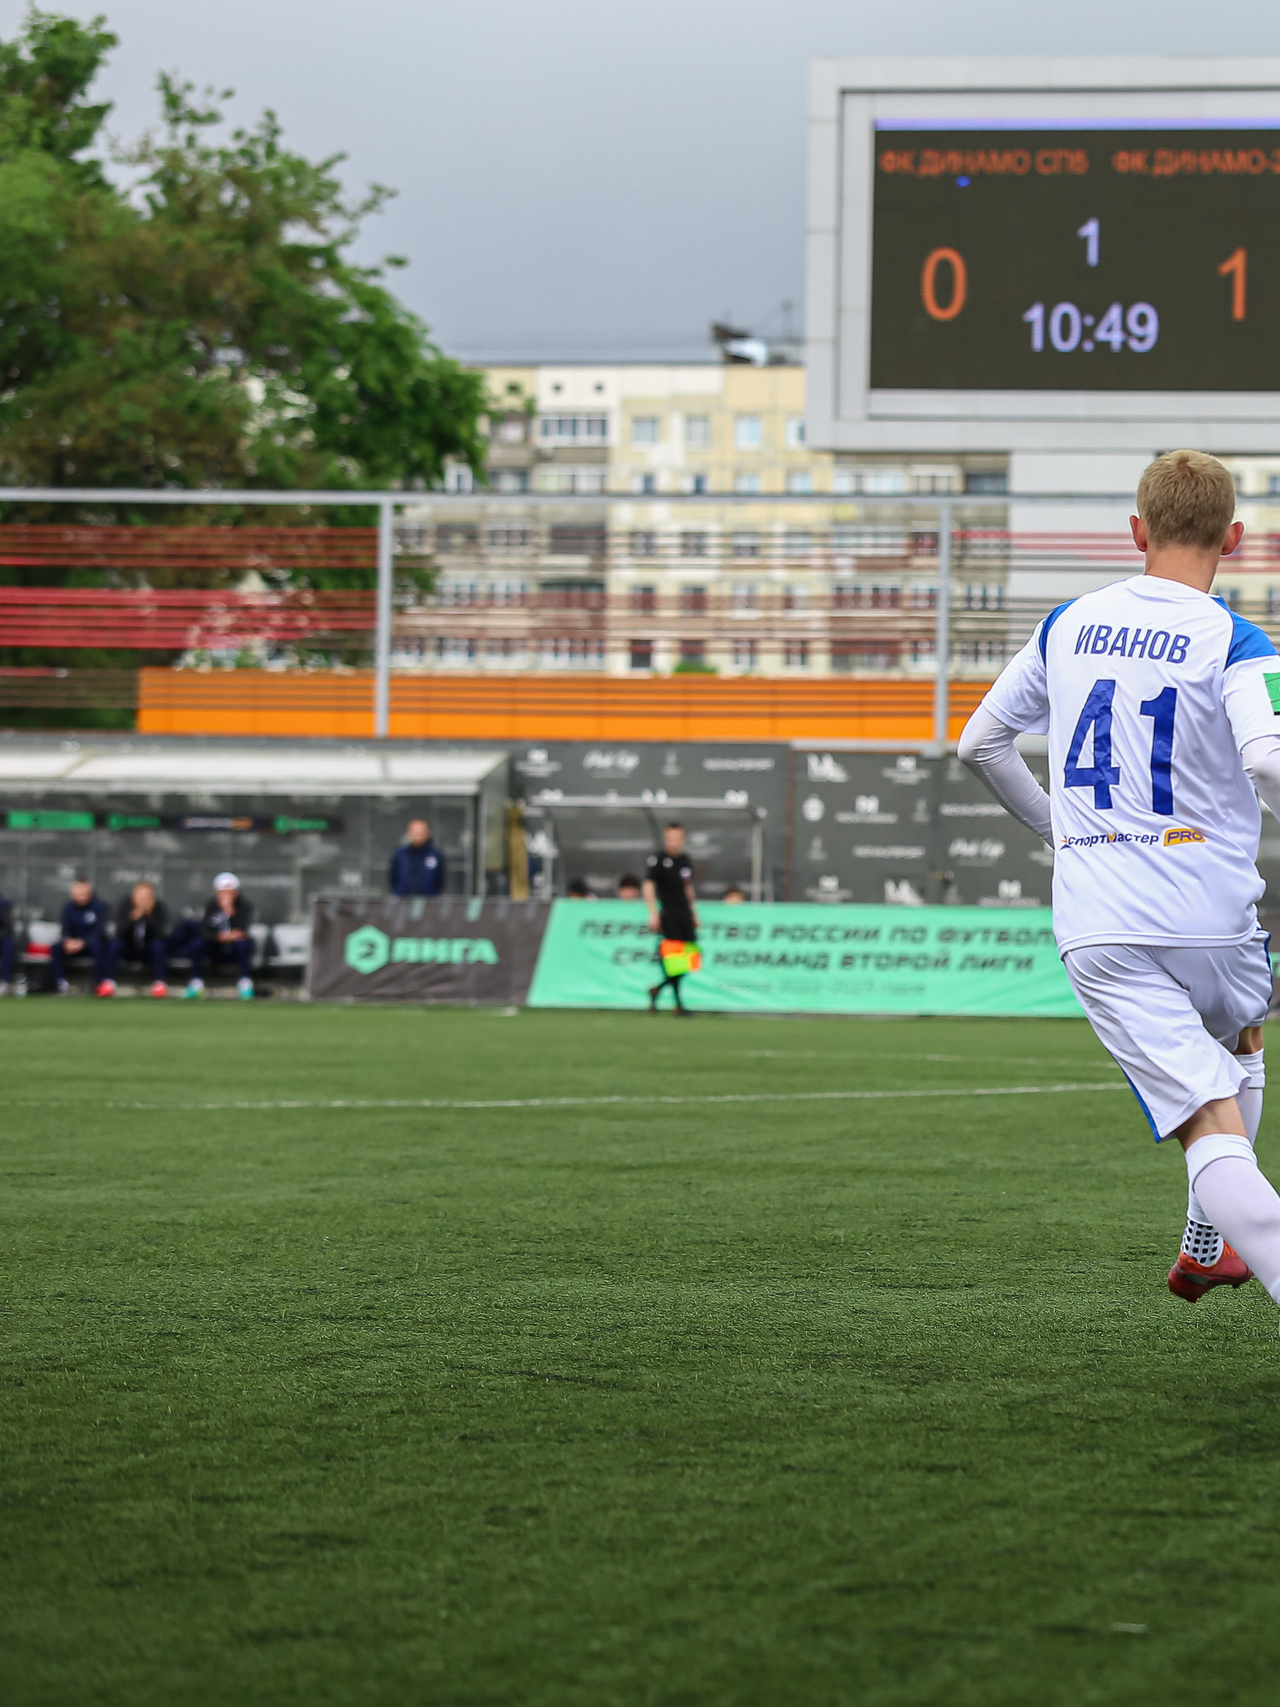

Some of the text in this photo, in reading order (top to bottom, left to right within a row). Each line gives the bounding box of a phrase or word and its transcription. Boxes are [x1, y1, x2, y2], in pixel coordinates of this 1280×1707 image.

[917, 148, 1032, 178] ДИНАМО
[1077, 217, 1100, 267] 1
[920, 247, 967, 321] 0
[1217, 246, 1247, 321] 1
[1022, 301, 1160, 353] 10:49
[1074, 624, 1191, 664] ИВАНОВ
[1063, 679, 1178, 816] 41
[1167, 830, 1204, 844] PRO
[391, 937, 499, 965] ЛИГА
[580, 920, 1055, 945] ПЕРВСТВО РОССИИ ПО ФУТБОЛ
[713, 951, 831, 971] КОМАНД
[840, 949, 952, 971] ВТОРОЙ
[958, 953, 1035, 972] ЛИГИ
